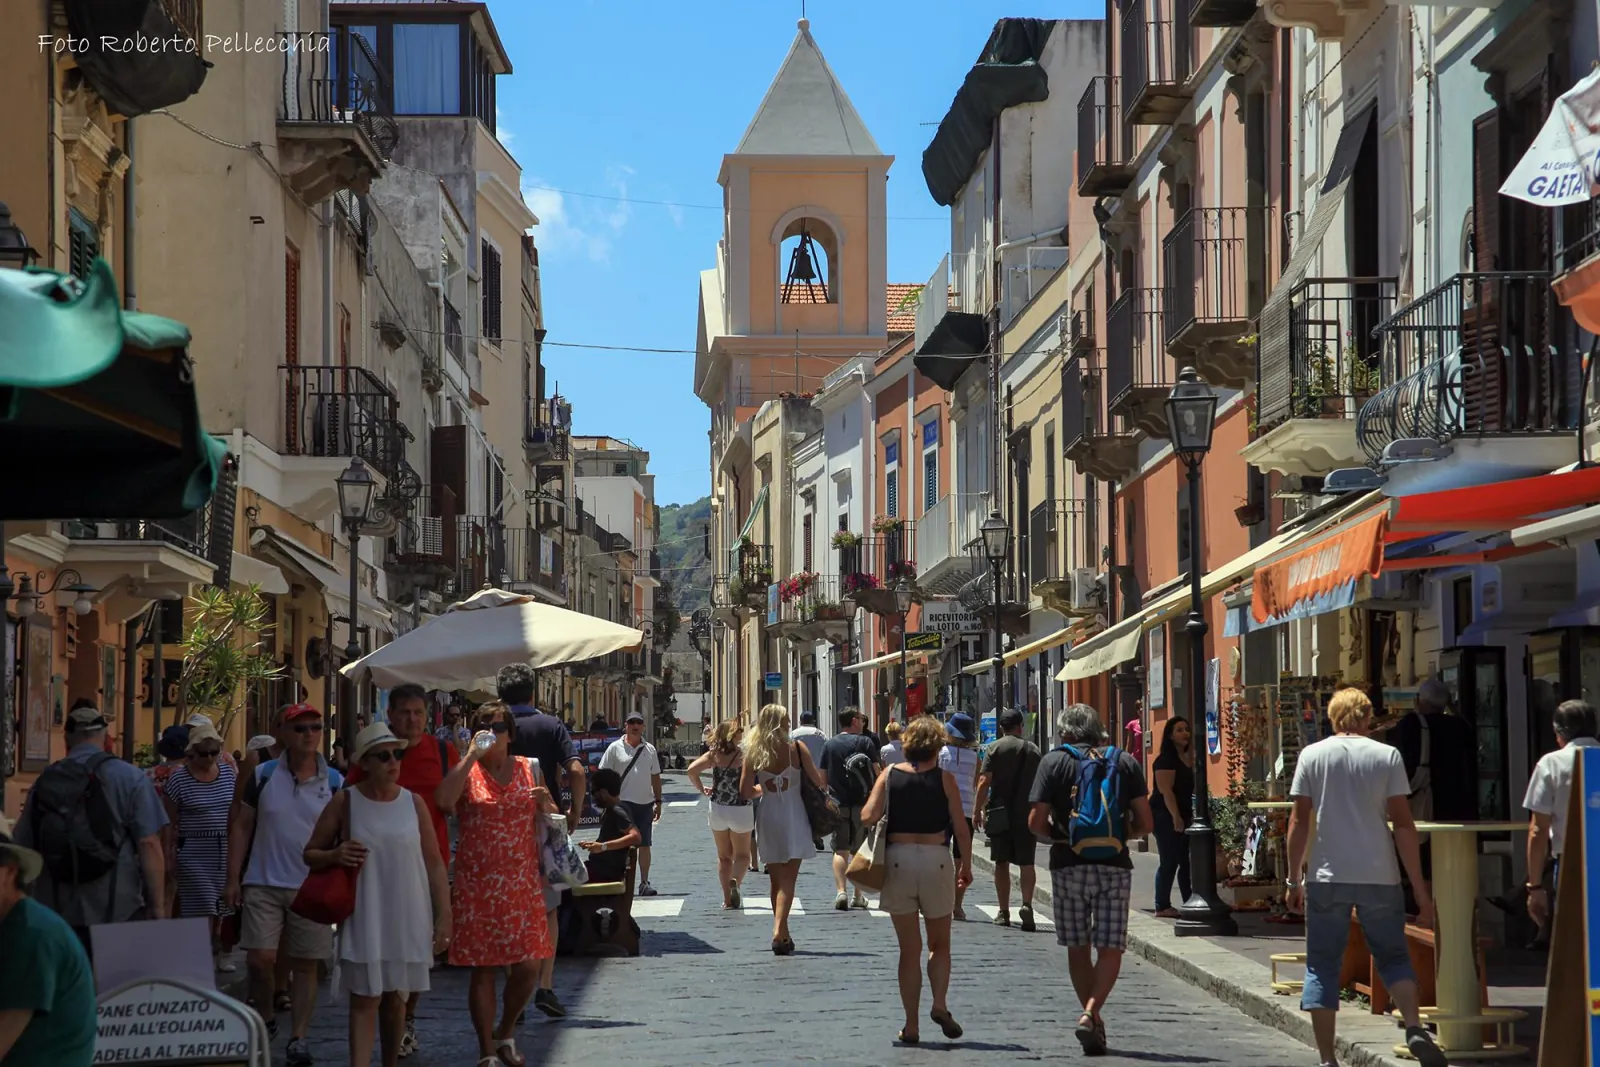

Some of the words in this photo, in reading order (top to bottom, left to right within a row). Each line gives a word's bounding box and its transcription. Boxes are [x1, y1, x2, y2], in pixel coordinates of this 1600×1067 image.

[929, 613, 977, 621] RICEVITORIA
[937, 622, 960, 631] LOTTO
[136, 1000, 210, 1016] CUNZATO
[128, 1019, 225, 1036] ALL'EOLIANA
[153, 1045, 174, 1058] AL
[178, 1041, 248, 1057] TARTUFO
